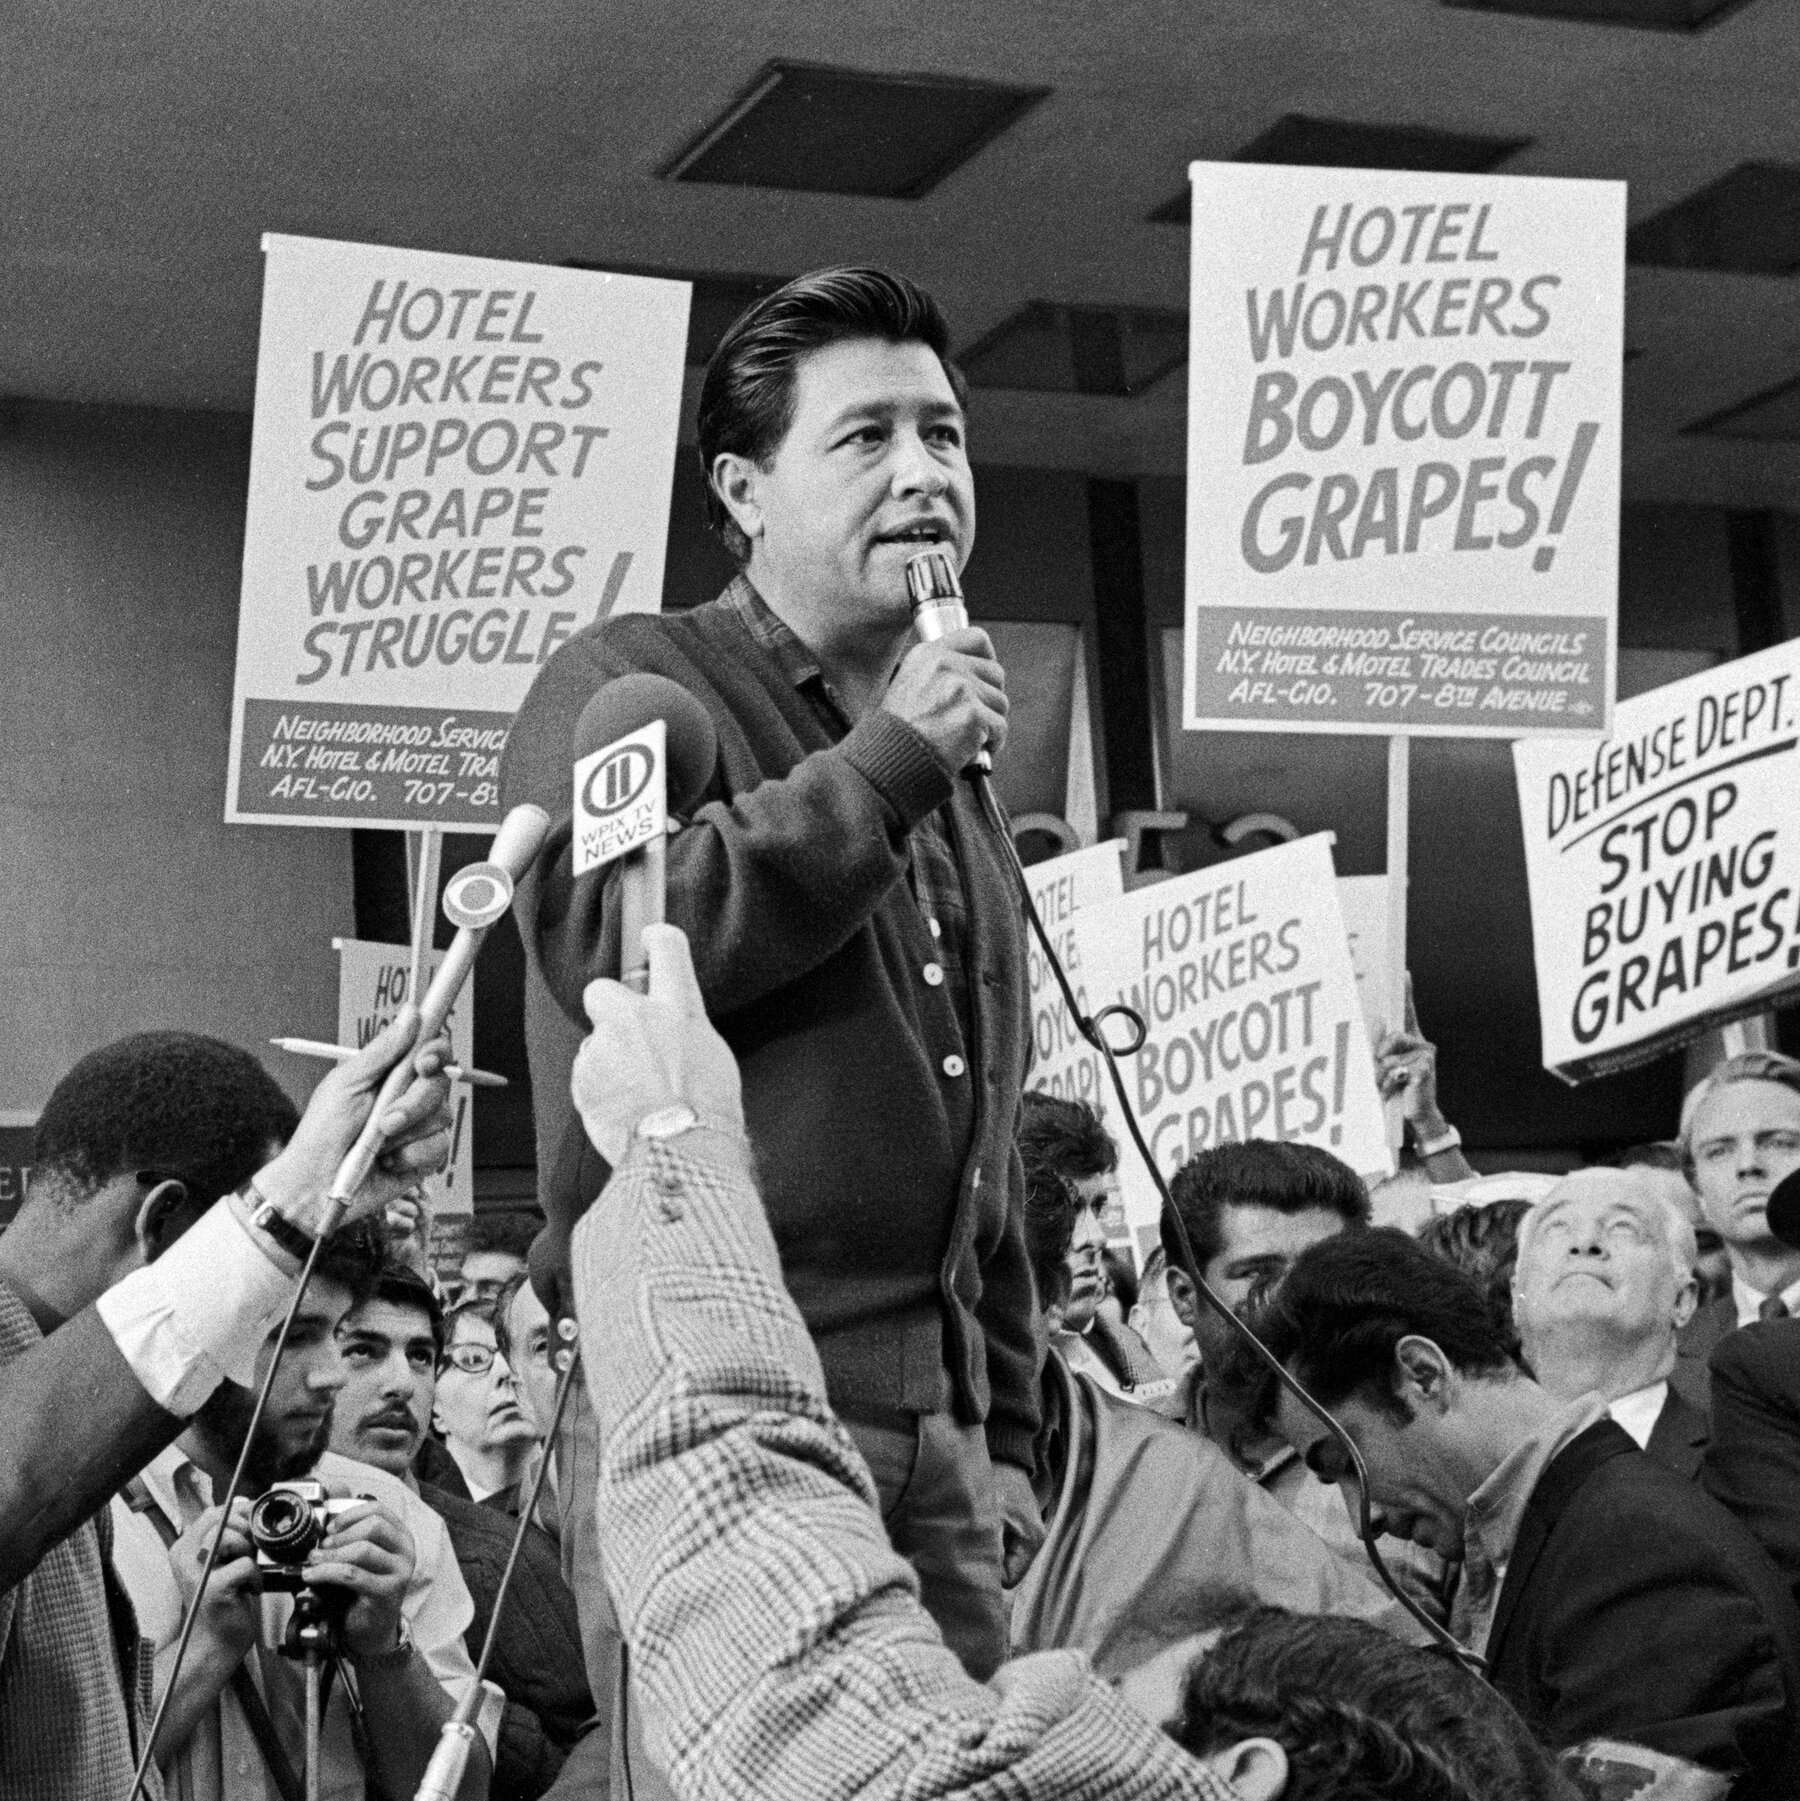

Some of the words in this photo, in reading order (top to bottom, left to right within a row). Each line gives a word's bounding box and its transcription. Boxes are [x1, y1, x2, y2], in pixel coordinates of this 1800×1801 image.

[1300, 203, 1499, 275] HOTEL
[352, 279, 545, 346] HOTEL
[1246, 275, 1561, 363] WORKERS
[310, 351, 603, 419] WORKERS
[1242, 361, 1571, 465] BOYCOTT
[304, 418, 610, 492] SUPPORT
[337, 487, 550, 550] GRAPE
[1240, 421, 1601, 574] GRAPES!
[305, 545, 587, 617] WORKERS
[1227, 620, 1391, 649] NEIGHBORHOOD
[1389, 618, 1478, 652] SERVICE
[1480, 626, 1587, 655] COUNCILS
[1261, 650, 1319, 675] HOTEL
[1340, 652, 1412, 678] MOTEL
[1420, 653, 1498, 680] TRADES
[1502, 655, 1590, 684] COUNCIL
[272, 714, 432, 746] NEIGHBORHOOD
[1480, 686, 1568, 712] AVENUE
[1697, 674, 1793, 759] DEPT.
[260, 743, 306, 769] N.Y.
[304, 745, 362, 771] HOTEL
[380, 748, 450, 775] MOTEL
[458, 751, 499, 777] TRA
[269, 774, 378, 801] AFL-CIO.
[582, 817, 624, 846] WPIX
[635, 799, 656, 819] TV
[585, 817, 654, 864] NEWS
[1599, 782, 1738, 894] STOP
[1036, 876, 1081, 928] OTEL
[1143, 880, 1258, 971] HOTEL
[1582, 830, 1778, 968] BUYING
[1118, 918, 1301, 1042] WORKERS
[1136, 981, 1322, 1117] BOYCOTT
[1151, 1021, 1350, 1178] GRAPES!
